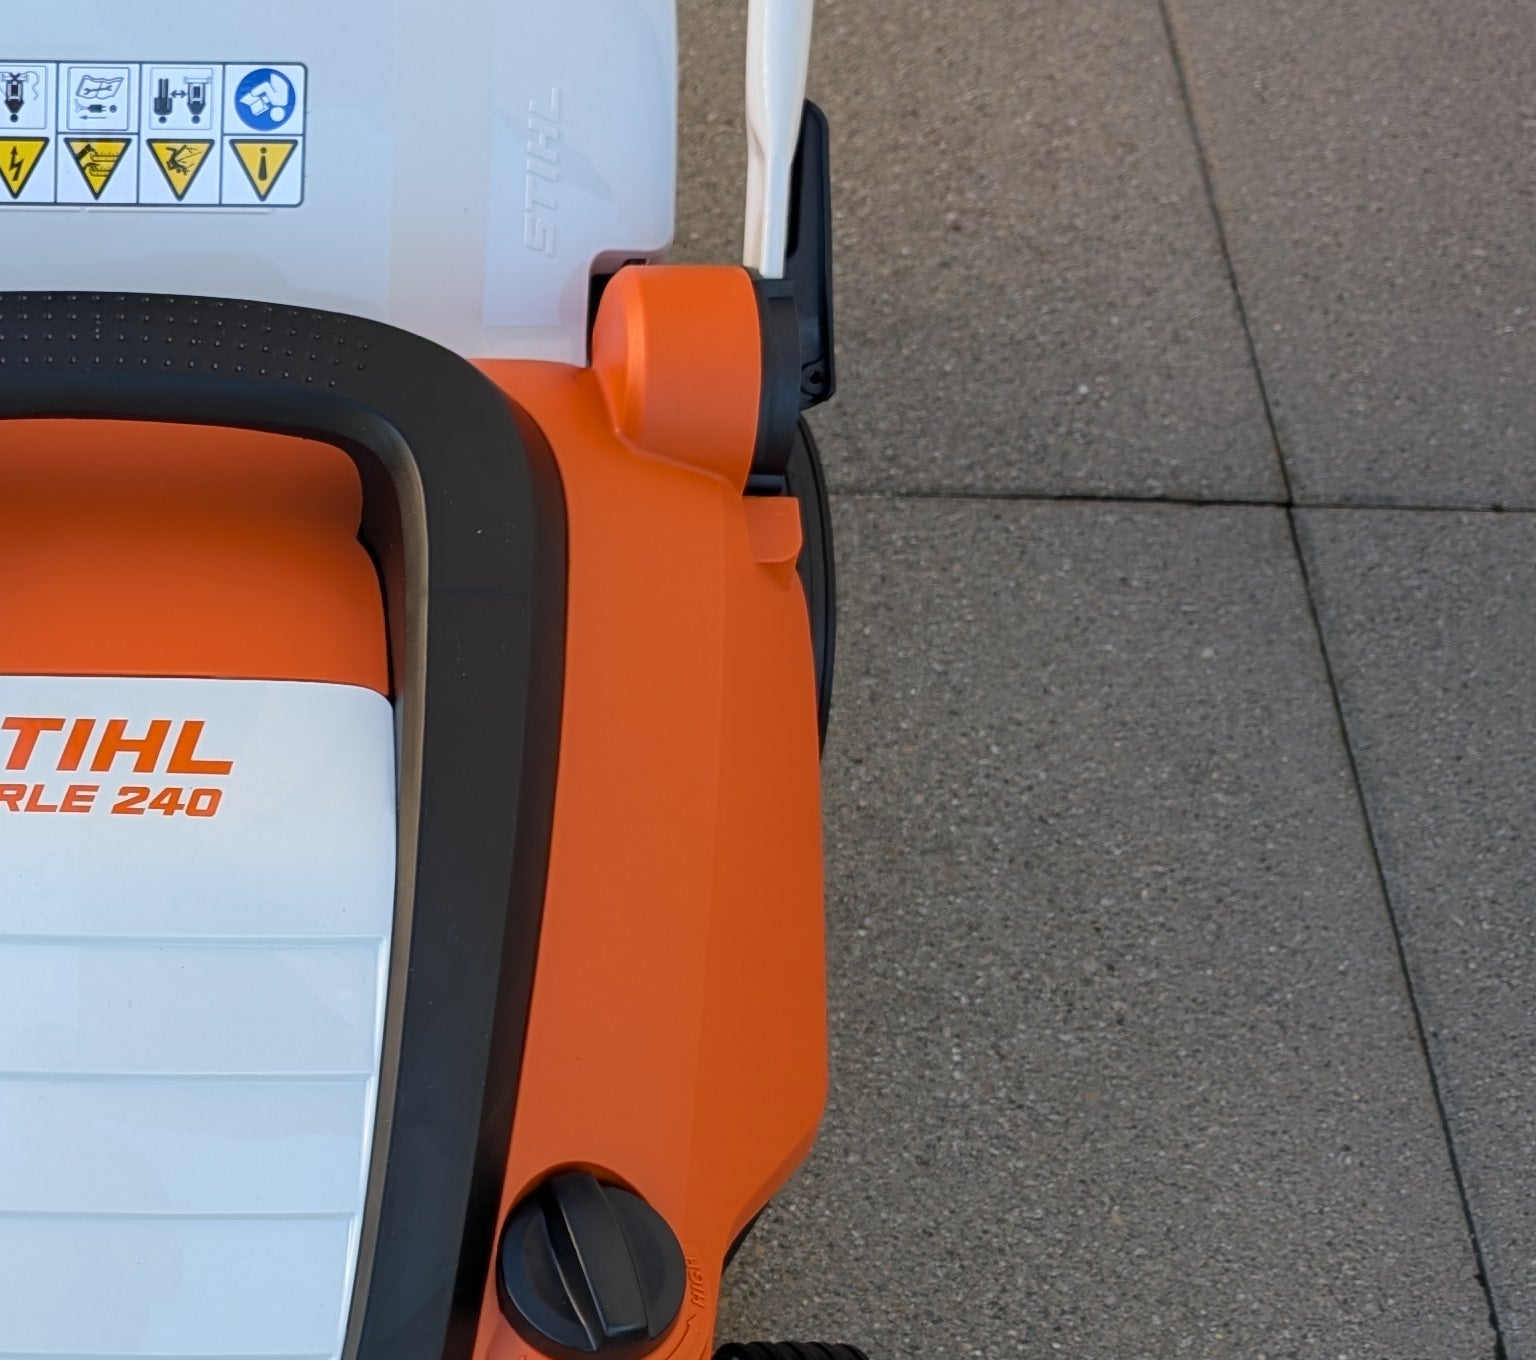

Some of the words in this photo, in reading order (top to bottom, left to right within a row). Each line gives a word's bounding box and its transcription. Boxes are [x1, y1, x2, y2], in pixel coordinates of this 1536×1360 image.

[523, 87, 560, 257] STIHL
[110, 785, 224, 818] 240
[685, 1255, 706, 1309] HIGH
